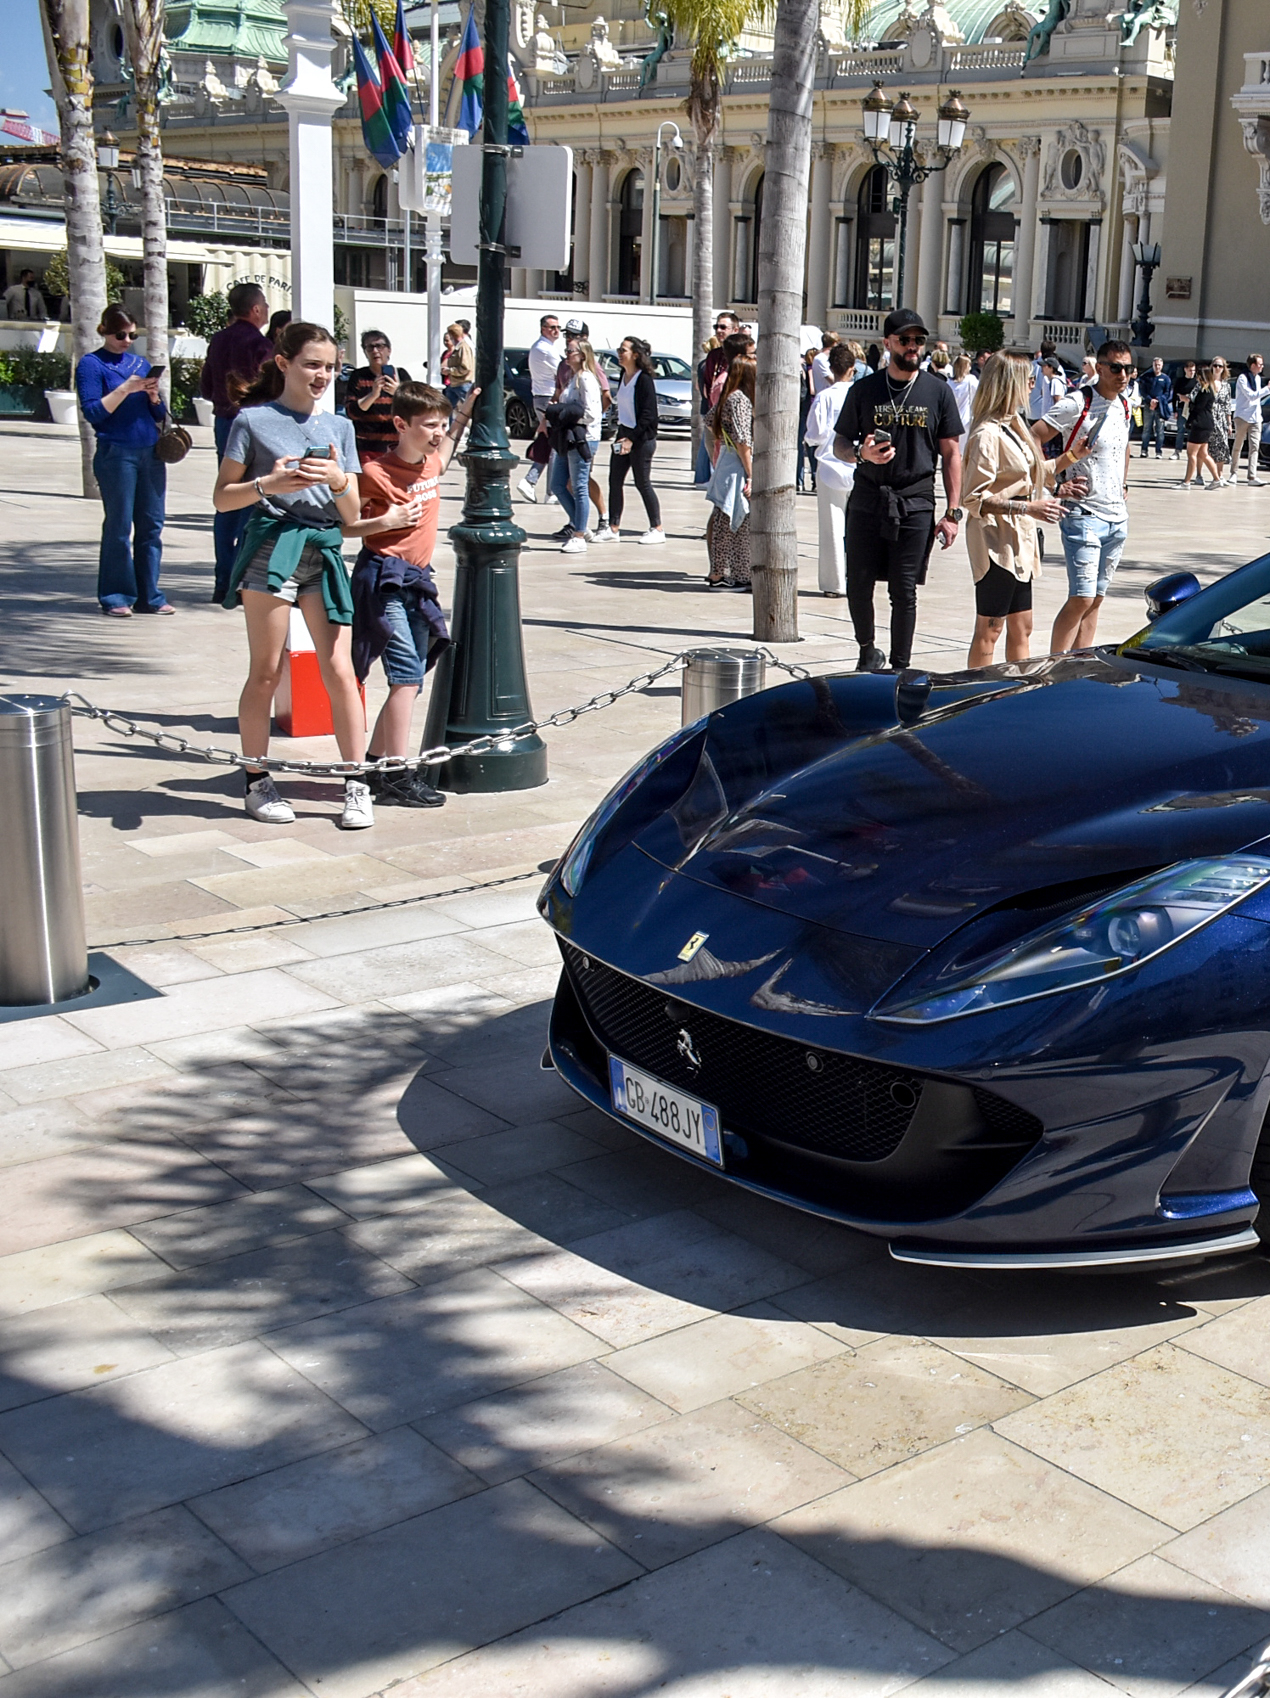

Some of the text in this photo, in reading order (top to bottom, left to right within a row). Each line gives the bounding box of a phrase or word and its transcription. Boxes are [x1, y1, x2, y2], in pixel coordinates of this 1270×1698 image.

[254, 274, 266, 283] DE
[269, 276, 293, 294] PARI
[874, 404, 905, 413] VERSCE
